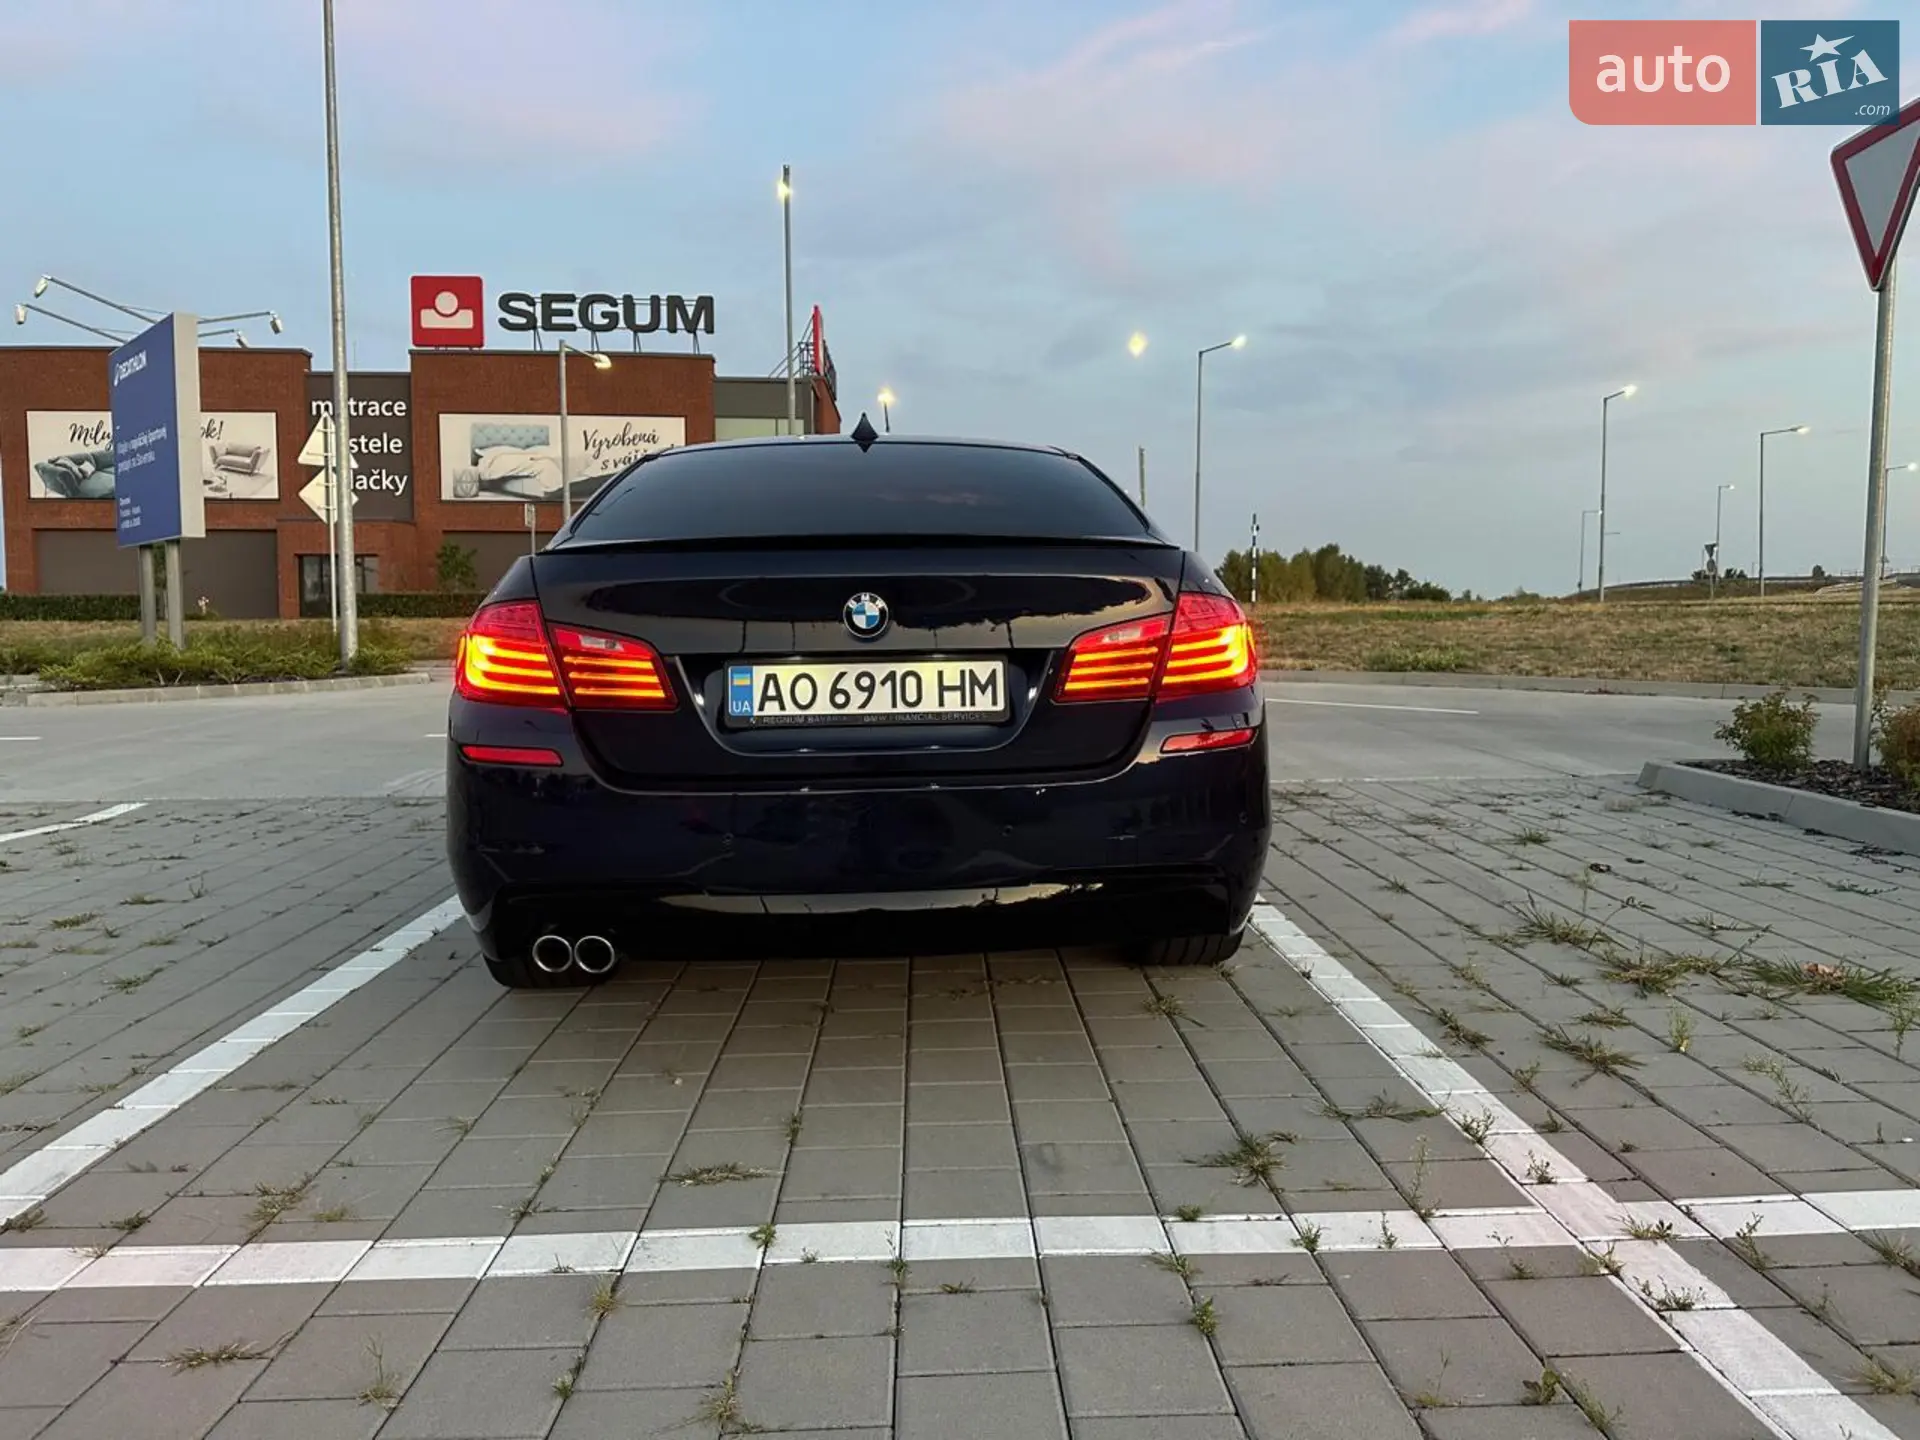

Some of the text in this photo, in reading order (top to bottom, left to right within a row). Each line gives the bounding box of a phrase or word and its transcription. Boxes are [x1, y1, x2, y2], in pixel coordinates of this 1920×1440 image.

[498, 292, 714, 334] SEGUM
[311, 398, 407, 416] mtrace
[349, 432, 403, 453] stele
[583, 421, 659, 460] Vyrobená
[601, 459, 610, 470] s
[757, 668, 998, 712] AO 6910 HM
[732, 702, 751, 713] UA
